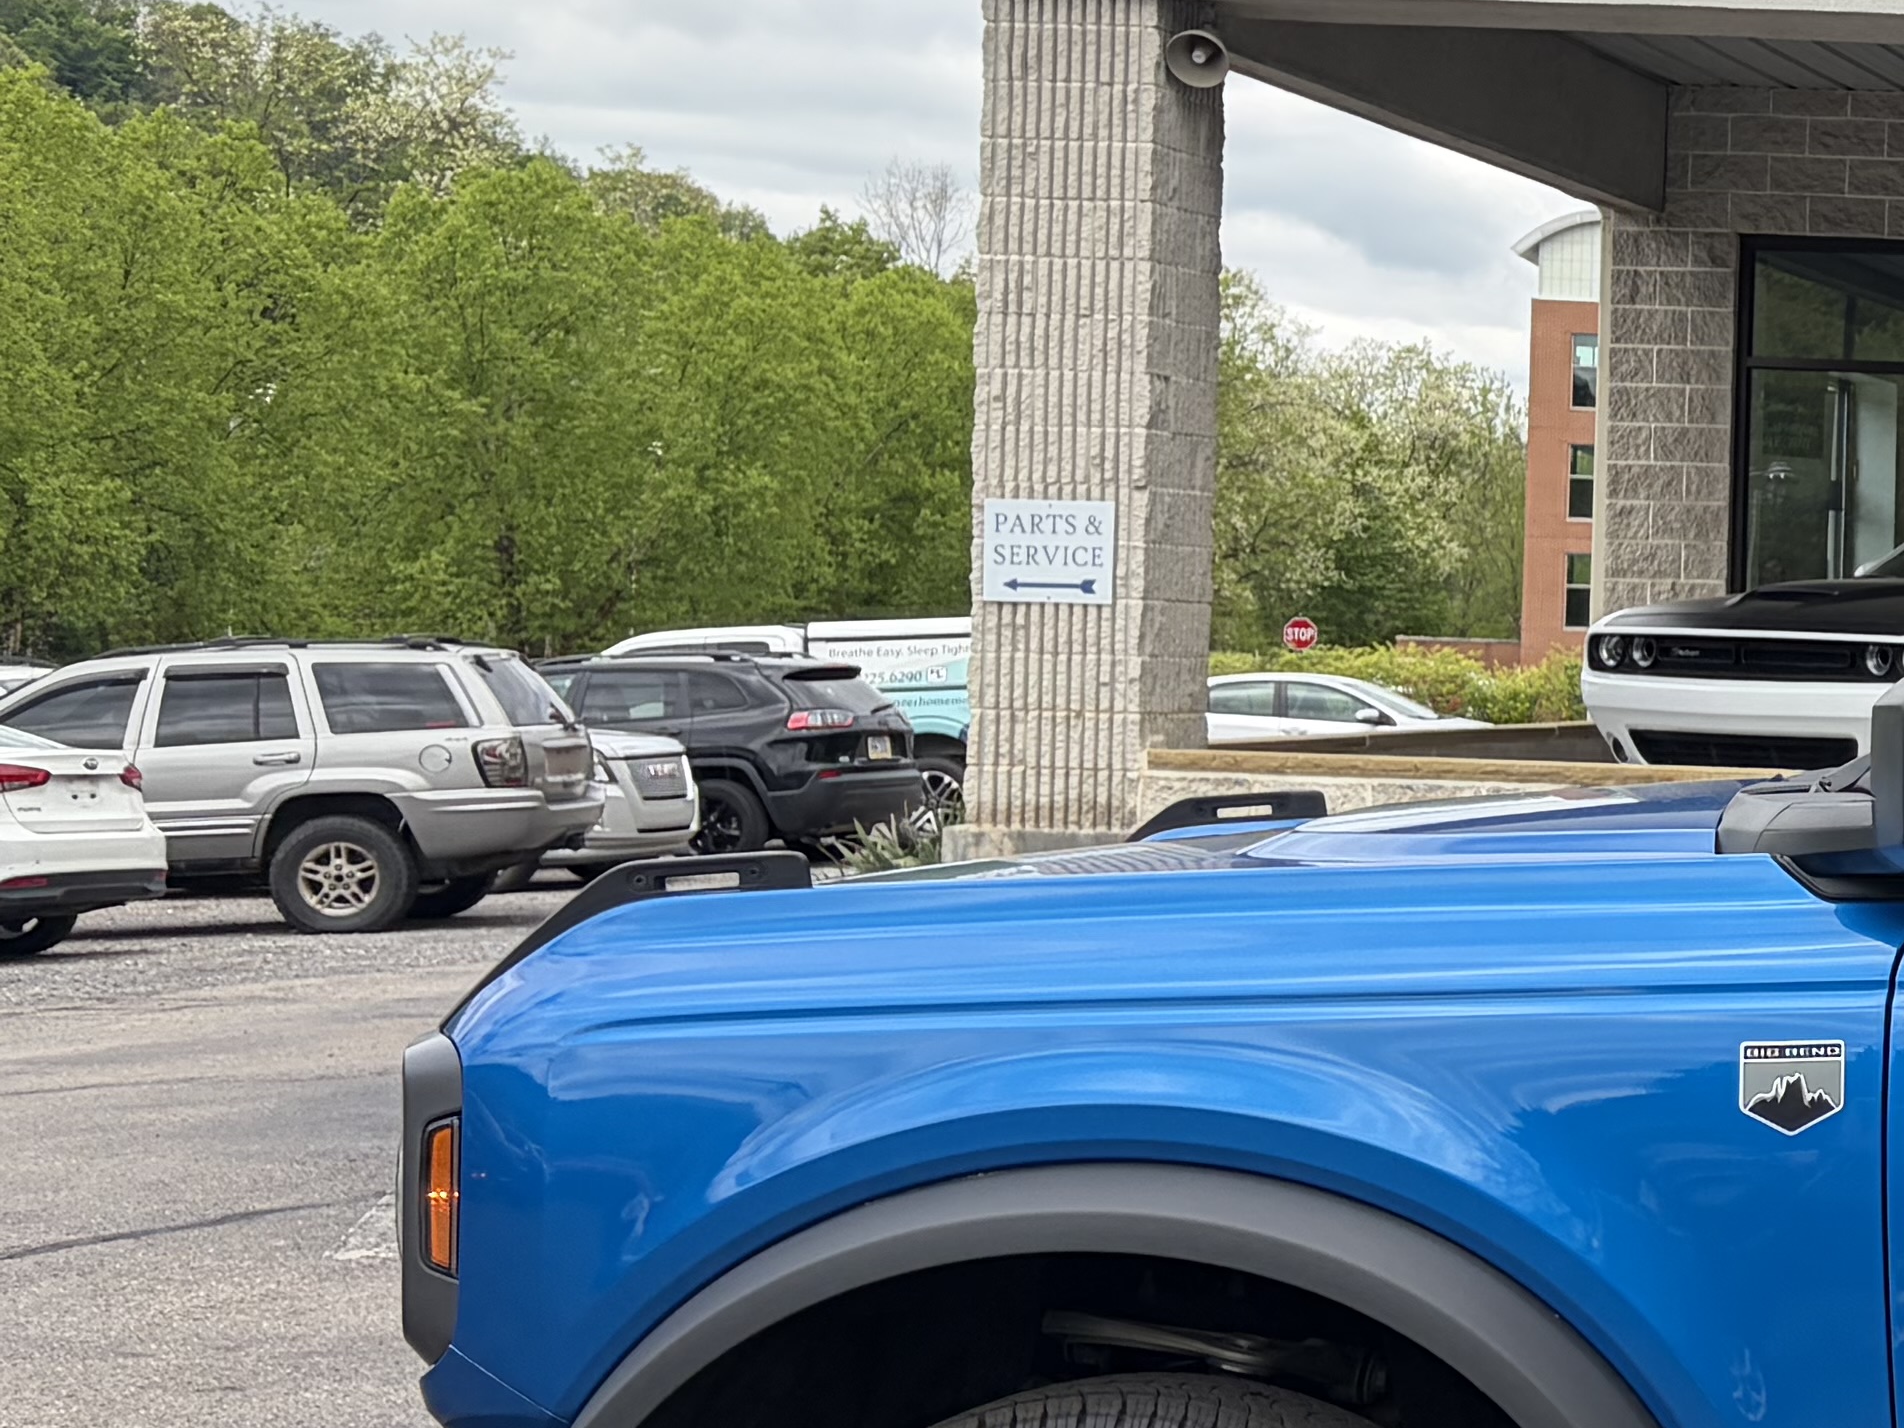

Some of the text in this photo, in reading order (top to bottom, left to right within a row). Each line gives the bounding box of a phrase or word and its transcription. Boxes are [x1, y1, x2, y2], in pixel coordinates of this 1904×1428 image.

[994, 513, 1103, 536] PARTS &
[993, 544, 1104, 568] SERVICE
[1286, 627, 1315, 641] STOP
[828, 647, 873, 658] Breathe
[907, 645, 938, 657] Sleep
